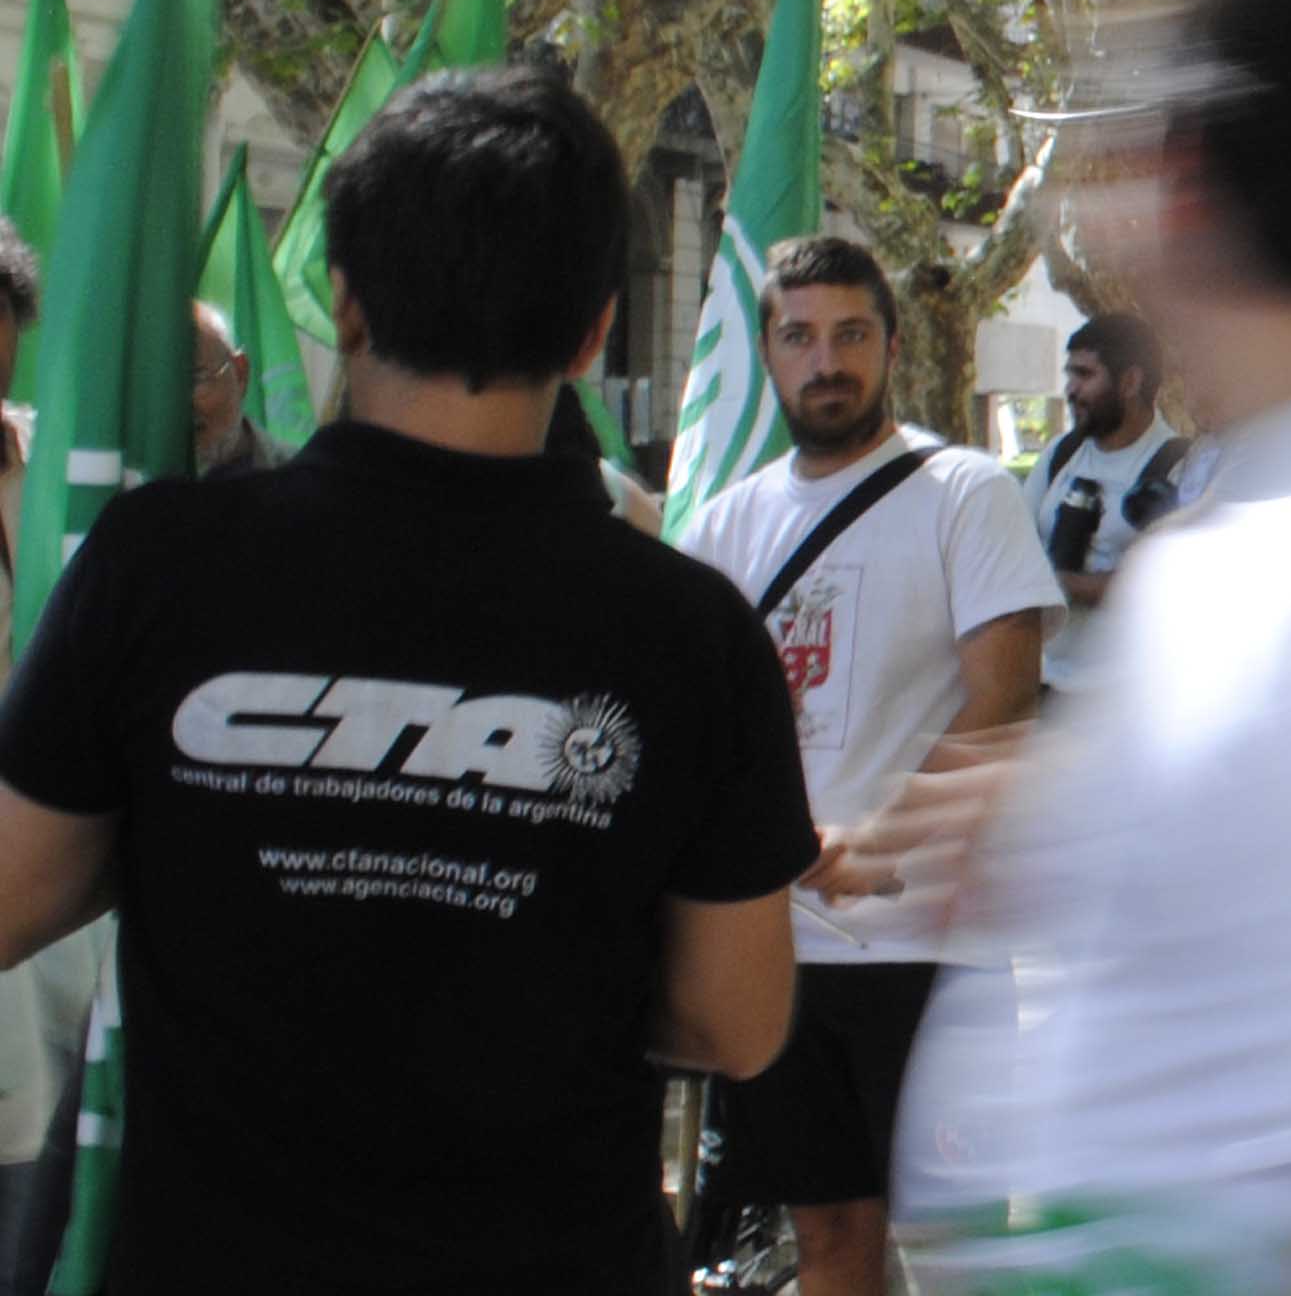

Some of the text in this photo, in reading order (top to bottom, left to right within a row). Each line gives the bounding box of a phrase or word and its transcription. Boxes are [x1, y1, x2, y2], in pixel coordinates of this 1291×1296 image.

[171, 670, 575, 794] CTA
[171, 764, 613, 830] central de trabajadores de la argentina
[258, 847, 538, 897] www.ctanacional.org
[279, 875, 517, 920] www.agenciacta.org
